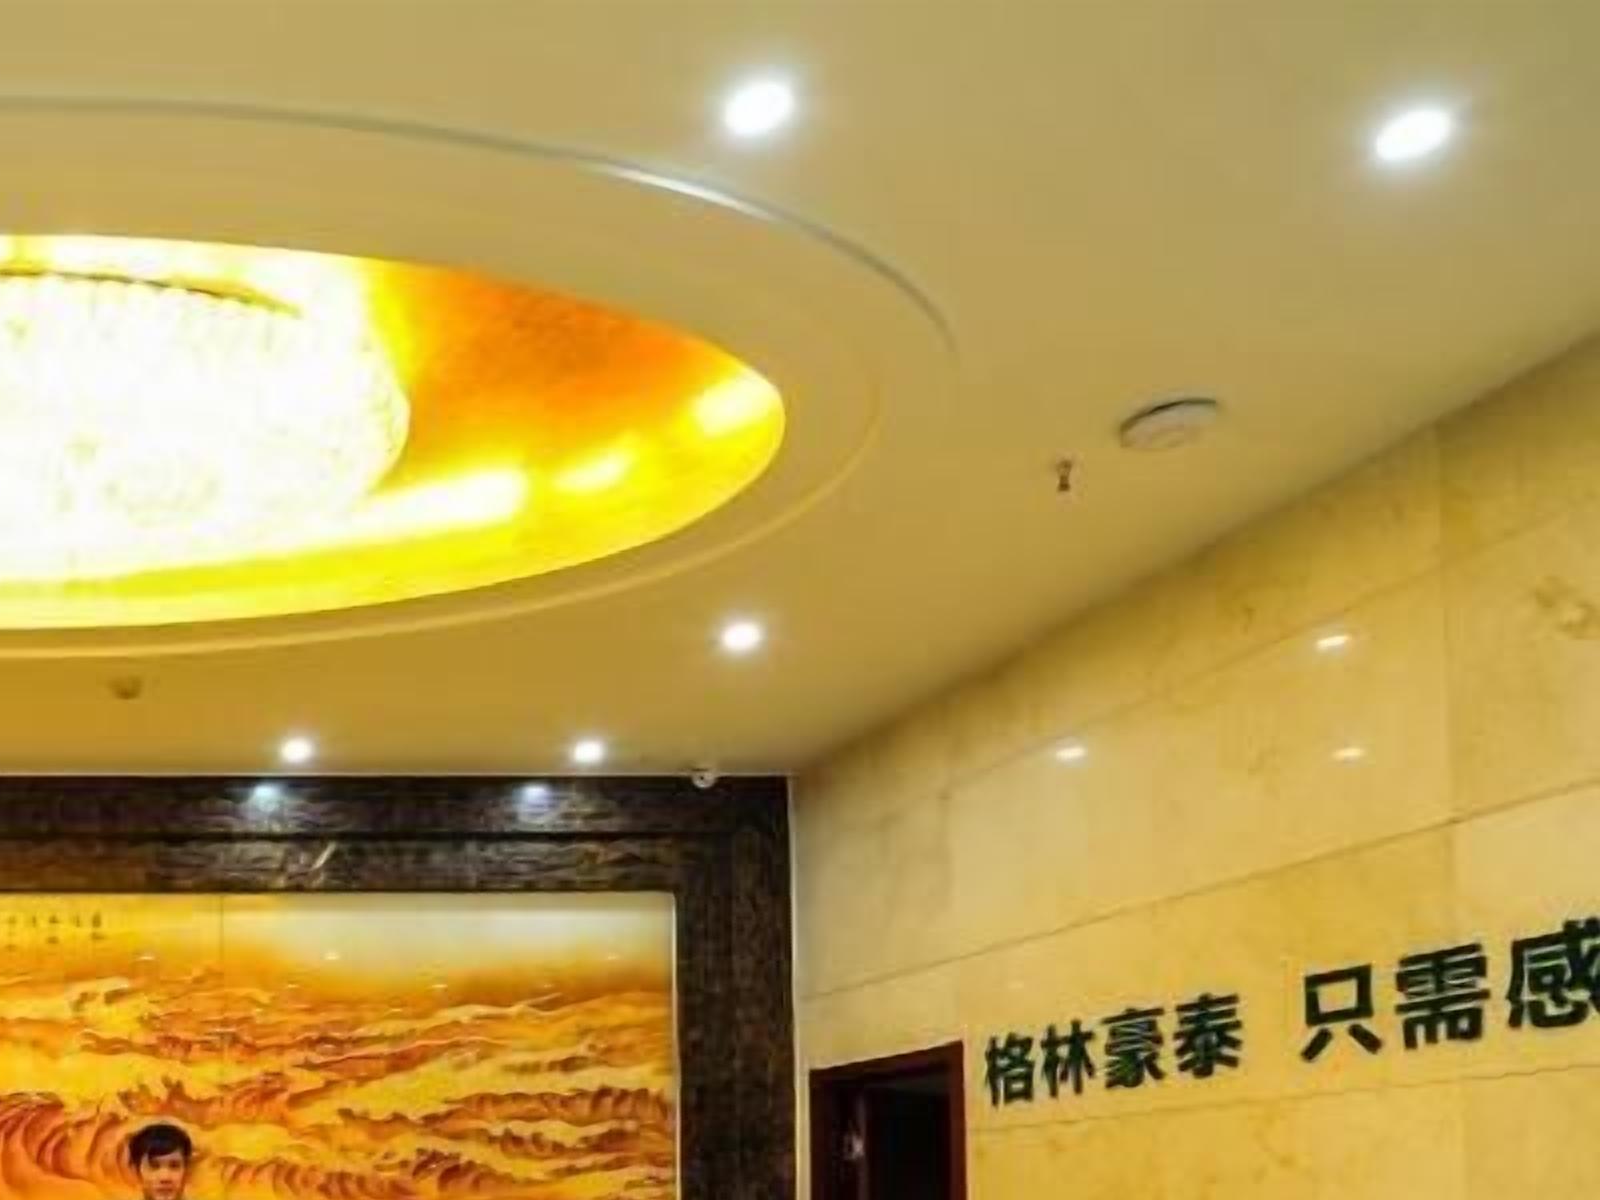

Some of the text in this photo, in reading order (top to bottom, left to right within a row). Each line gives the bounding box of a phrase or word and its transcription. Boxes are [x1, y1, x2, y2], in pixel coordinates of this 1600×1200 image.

[984, 916, 1600, 1108] 格林豪泰 只需感
